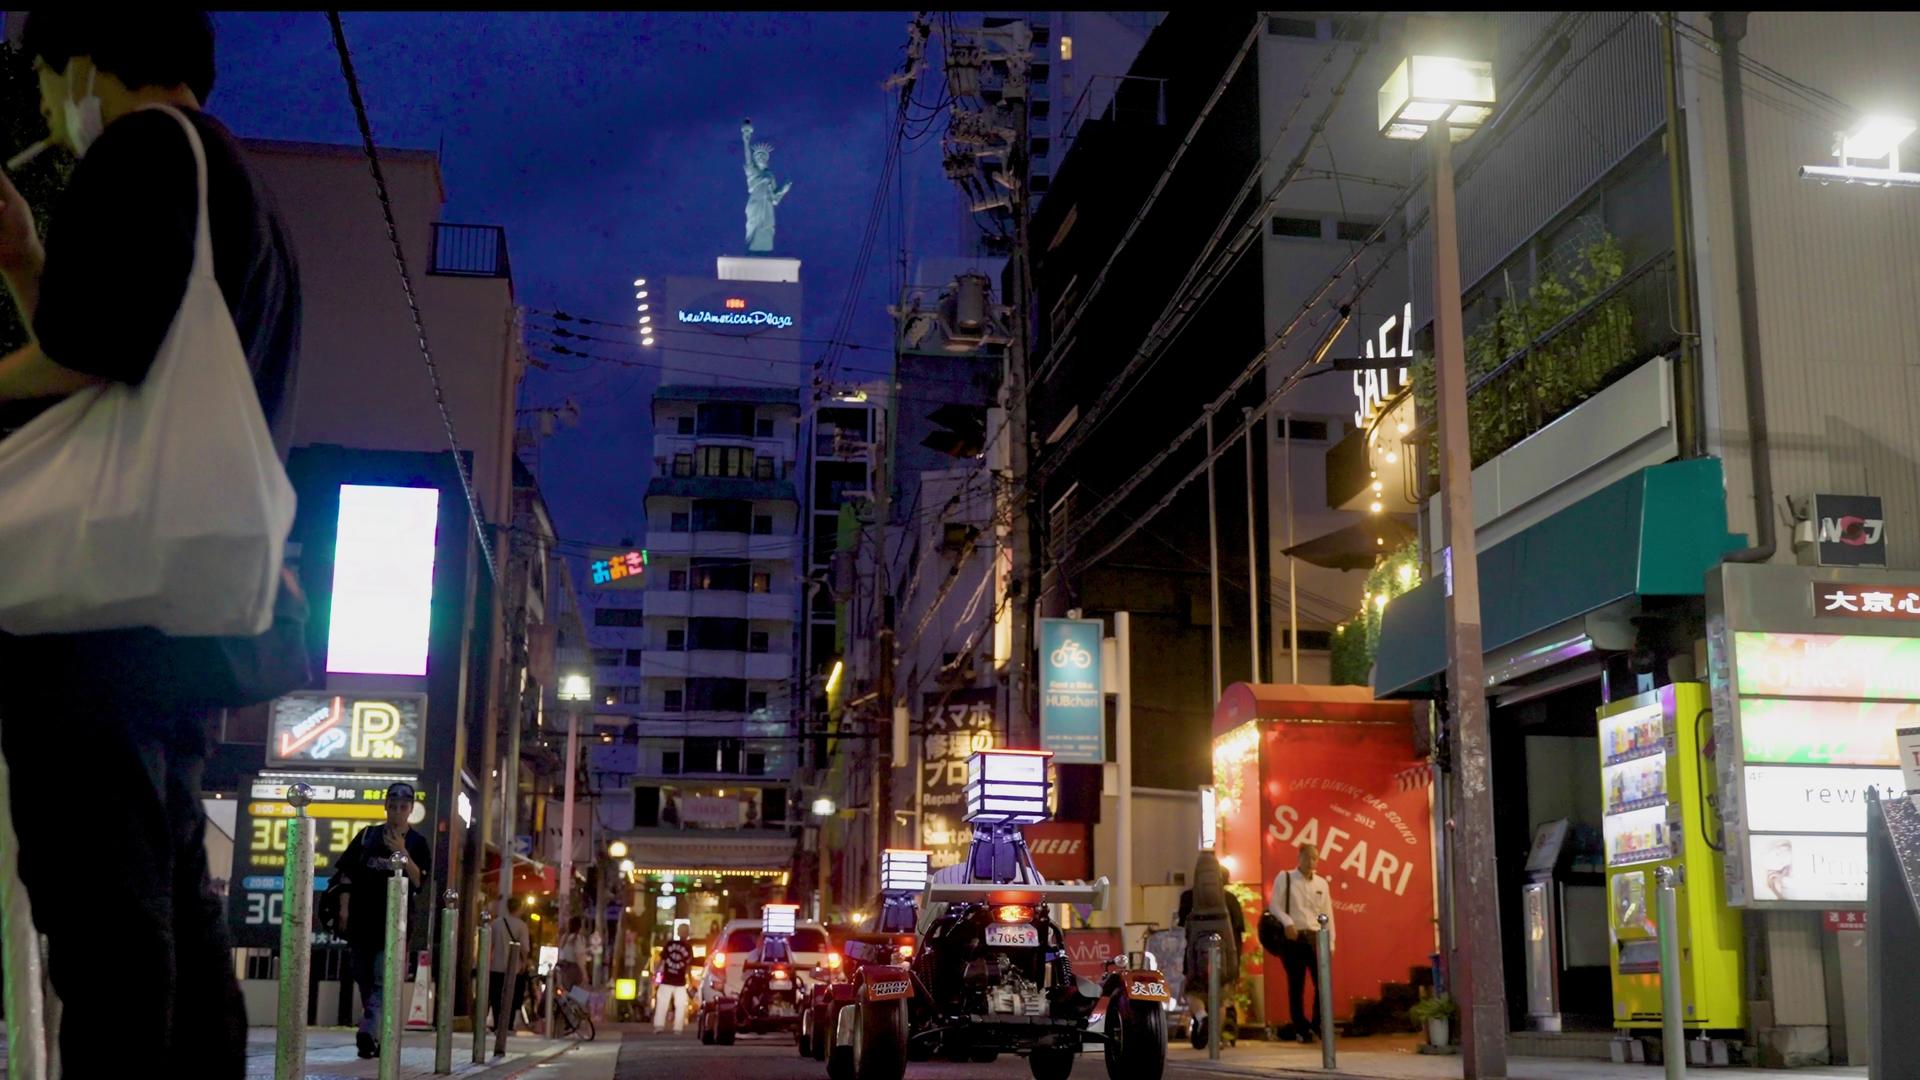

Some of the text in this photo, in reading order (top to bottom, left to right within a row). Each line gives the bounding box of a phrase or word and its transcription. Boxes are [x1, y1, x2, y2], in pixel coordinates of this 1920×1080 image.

[678, 311, 793, 329] New American Plaza
[926, 701, 992, 728] スマホ
[351, 701, 401, 758] P
[925, 759, 968, 788] プロ
[924, 793, 960, 806] Repair
[1289, 776, 1418, 845] CAFE DINING BAR SOUND
[1354, 813, 1377, 829] 2012
[1268, 804, 1415, 896] SAFARI
[997, 933, 1025, 944] 7065
[871, 981, 908, 990] JAPAN
[876, 987, 906, 995] KART
[1131, 981, 1169, 996] 大阪
